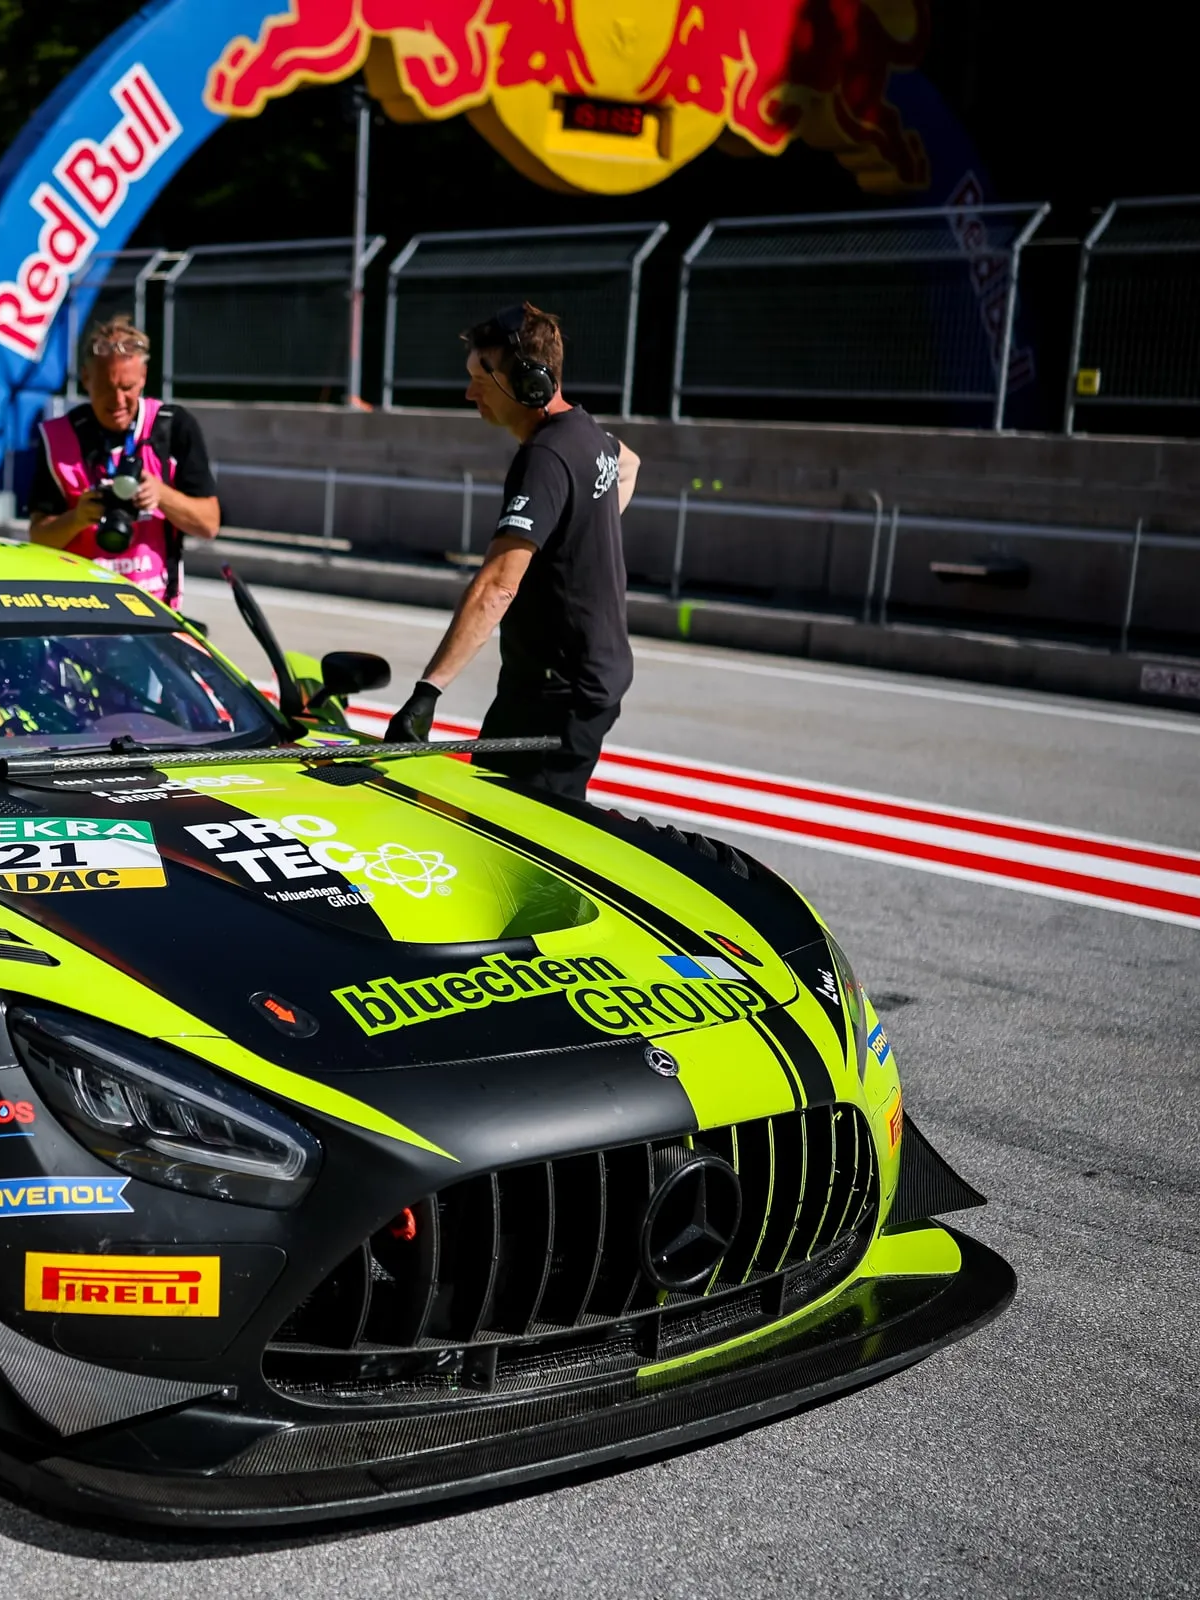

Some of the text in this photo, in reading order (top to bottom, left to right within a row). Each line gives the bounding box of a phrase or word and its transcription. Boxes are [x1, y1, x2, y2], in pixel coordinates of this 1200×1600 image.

[59, 68, 179, 223] Bull
[0, 592, 43, 608] Full
[43, 594, 110, 611] Speed.
[107, 791, 170, 804] GROUP
[183, 814, 338, 849] PRO
[215, 840, 367, 883] TEC
[280, 884, 343, 902] bluechem
[327, 890, 376, 908] GROUP
[343, 954, 628, 1030] bluechem
[572, 982, 760, 1031] GROUP
[42, 1266, 202, 1305] PIRELLI
